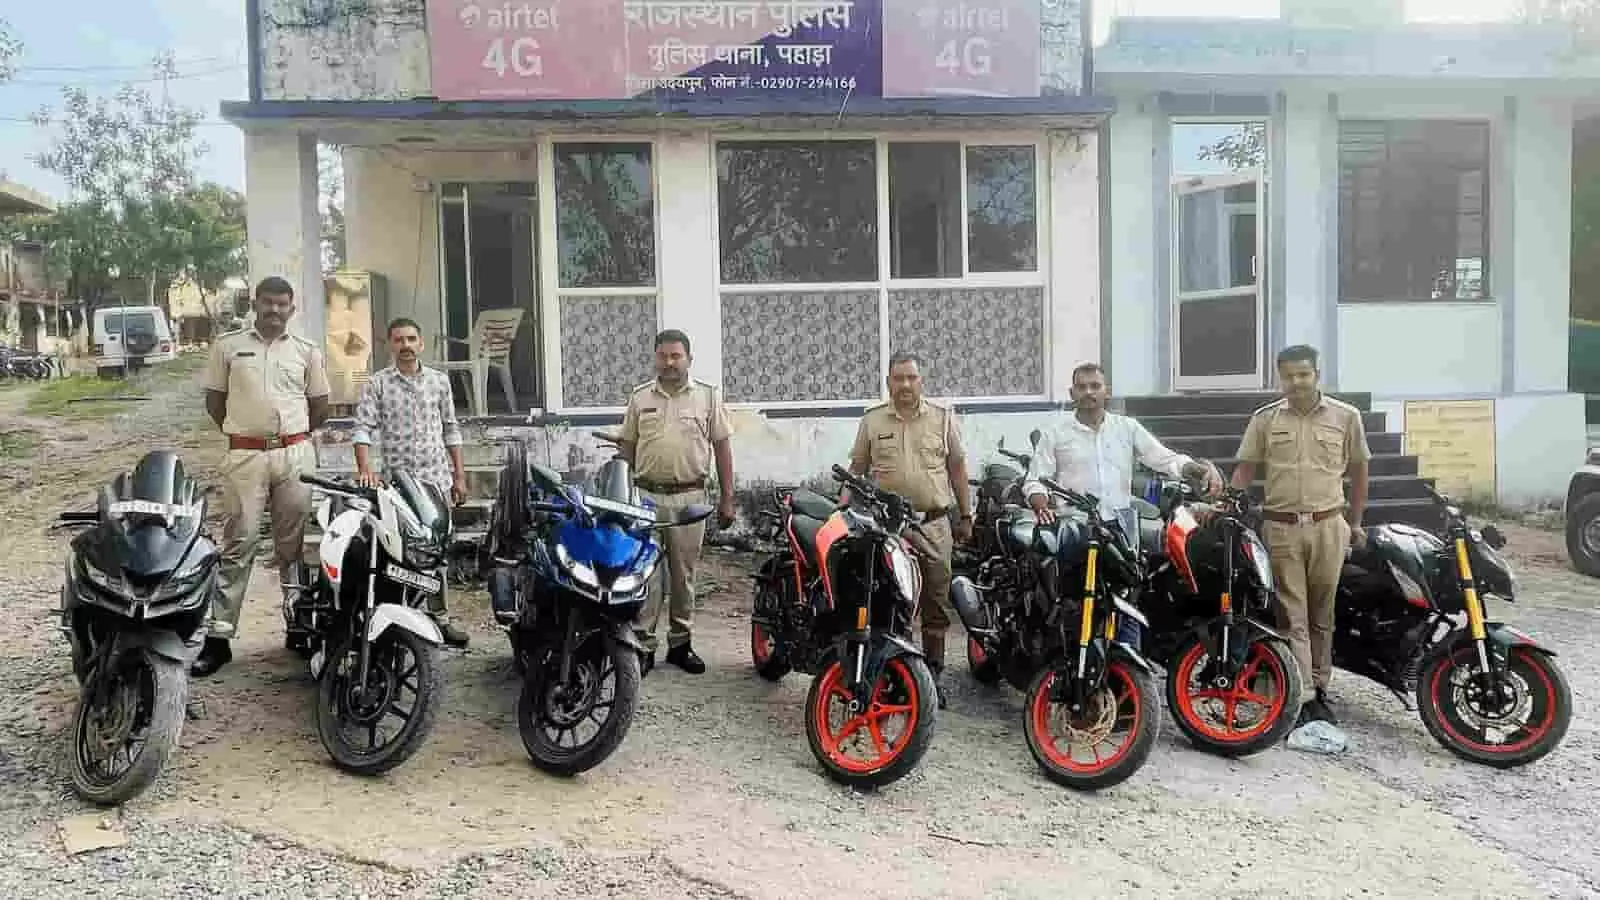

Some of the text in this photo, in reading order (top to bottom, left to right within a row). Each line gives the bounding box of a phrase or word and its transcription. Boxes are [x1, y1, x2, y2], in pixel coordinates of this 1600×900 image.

[487, 1, 560, 30] airtel
[623, 0, 854, 37] राजस्थान पुलिस
[481, 37, 543, 78] 4G
[647, 36, 710, 71] पुलिस
[712, 43, 770, 68] थाना,
[935, 37, 991, 77] 4G
[711, 72, 737, 89] फोन
